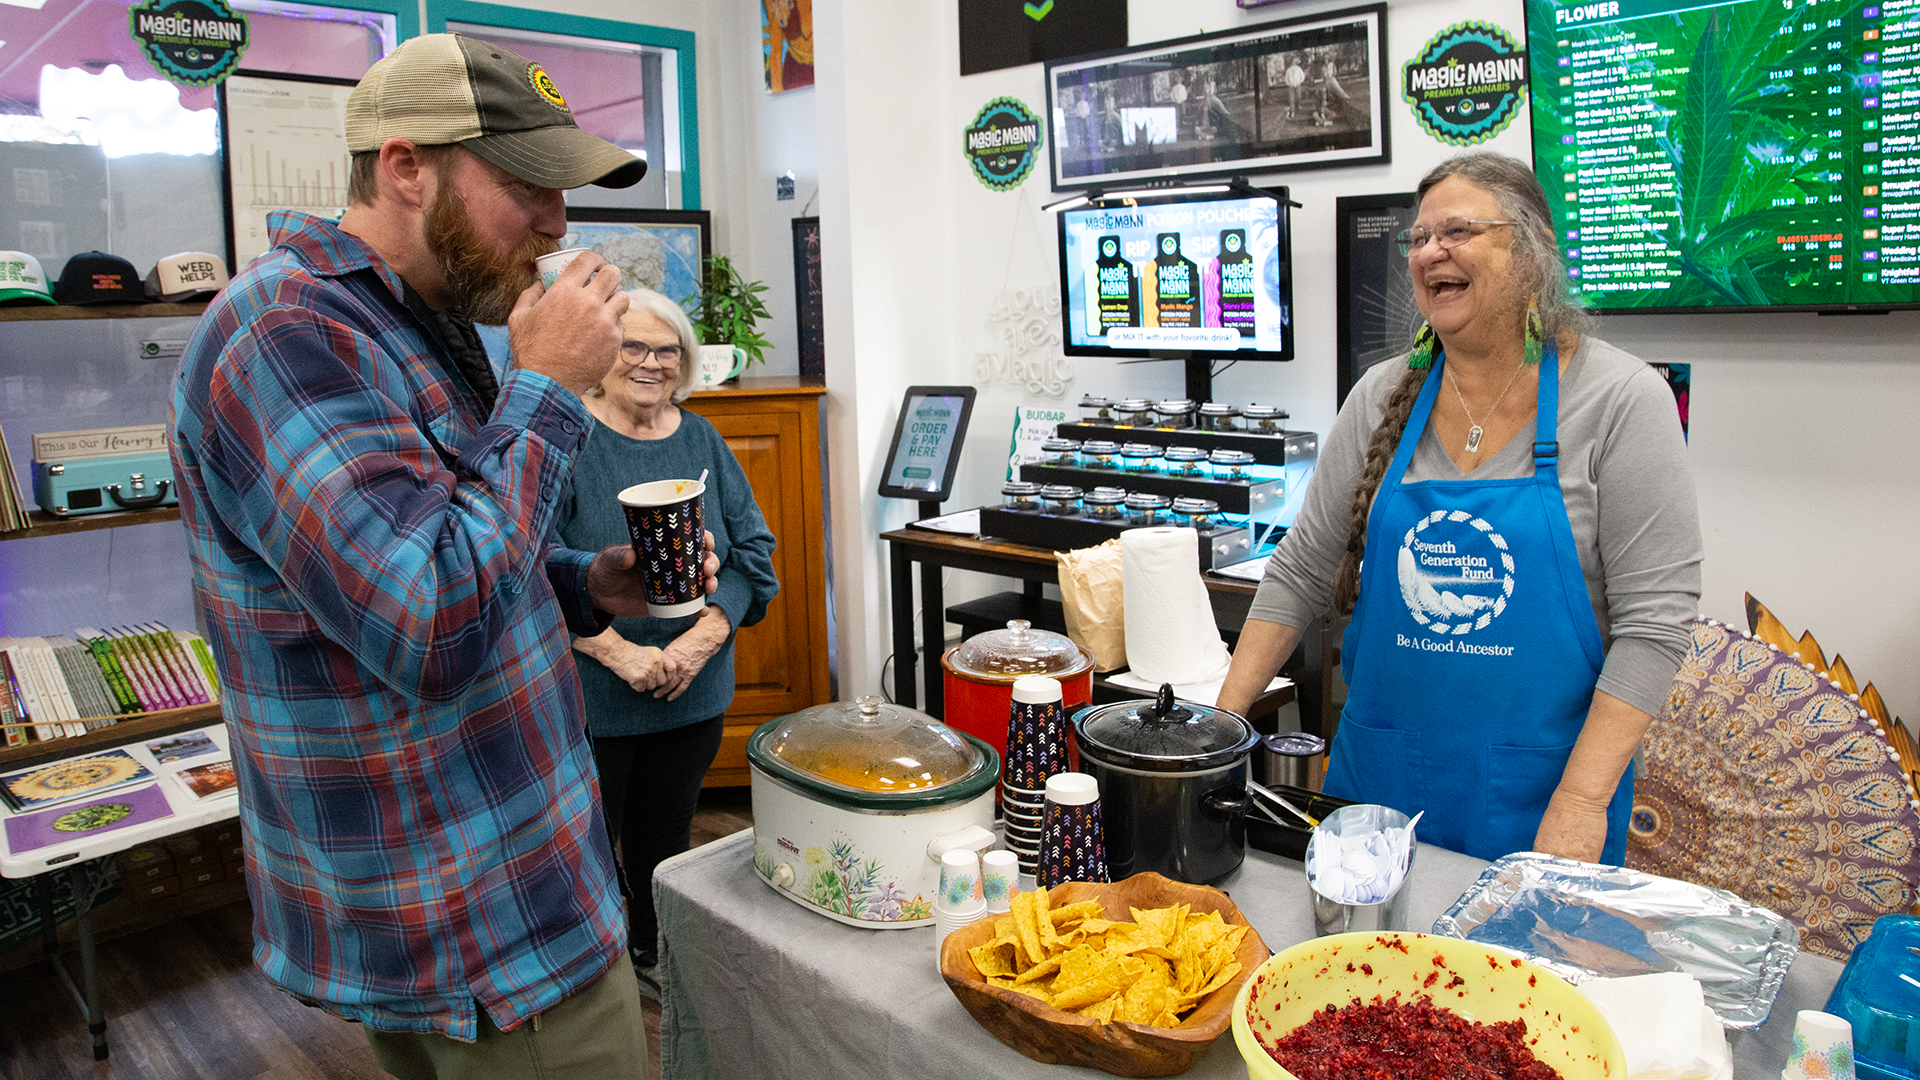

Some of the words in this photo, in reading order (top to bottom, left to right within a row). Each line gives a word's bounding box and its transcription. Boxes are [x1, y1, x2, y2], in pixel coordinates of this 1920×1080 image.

[1556, 1, 1619, 24] FLOWER
[1779, 26, 1793, 35] $13
[1827, 18, 1842, 28] $42
[1882, 22, 1903, 33] Jack
[153, 35, 191, 44] PREMIUM
[192, 38, 230, 48] CANNABIS
[1882, 33, 1901, 41] Magic
[1827, 41, 1842, 50] $40
[1827, 63, 1842, 73] $40
[1882, 68, 1912, 79] Kosher
[1424, 86, 1463, 99] PREMIUM
[1466, 82, 1510, 95] CANNABIS
[1827, 86, 1842, 95] $42
[1446, 105, 1456, 113] VT
[1476, 102, 1490, 110] USA
[1828, 108, 1842, 117] $45
[1882, 113, 1912, 123] Mellow
[1828, 129, 1842, 139] $40
[1882, 135, 1916, 146] Pudding
[977, 147, 1000, 155] PREMIUM
[1001, 144, 1028, 153] CANNABIS
[1828, 151, 1842, 160] $44
[1805, 195, 1819, 205] $27
[1828, 194, 1843, 203] $44
[1147, 211, 1194, 227] POTION
[1197, 208, 1251, 223] POUCHE
[1890, 211, 1918, 219] Medicine
[1881, 225, 1906, 235] Super
[1126, 239, 1151, 258] RIP
[1191, 236, 1217, 253] SIP
[1881, 246, 1917, 256] Wedding
[1890, 255, 1917, 263] Medicine
[177, 261, 213, 273] WEED
[1132, 260, 1145, 278] IT
[1828, 262, 1843, 270] $40
[180, 272, 216, 284] HELPS
[1881, 267, 1919, 278] Knightfall
[1117, 304, 1128, 312] Drop
[1146, 333, 1161, 341] with
[1163, 335, 1178, 343] your
[1181, 333, 1209, 341] favorite
[1212, 334, 1233, 342] drink!
[1026, 410, 1066, 422] BUDBAR
[911, 422, 948, 434] ORDER
[1019, 427, 1026, 440] 1.
[41, 442, 66, 452] This
[69, 441, 77, 450] is
[80, 439, 99, 449] Our
[104, 434, 154, 450] Happy
[911, 434, 919, 445] &
[921, 434, 941, 445] PAY
[1033, 434, 1042, 442] Jar
[908, 446, 938, 457] HERE
[1024, 454, 1037, 462] Look
[1413, 538, 1457, 554] Seventh
[1420, 552, 1487, 567] Generation
[1461, 566, 1495, 579] Fund
[1397, 633, 1411, 647] Be
[1411, 637, 1420, 650] A
[1421, 639, 1454, 652] Good
[1456, 641, 1515, 656] Ancestor
